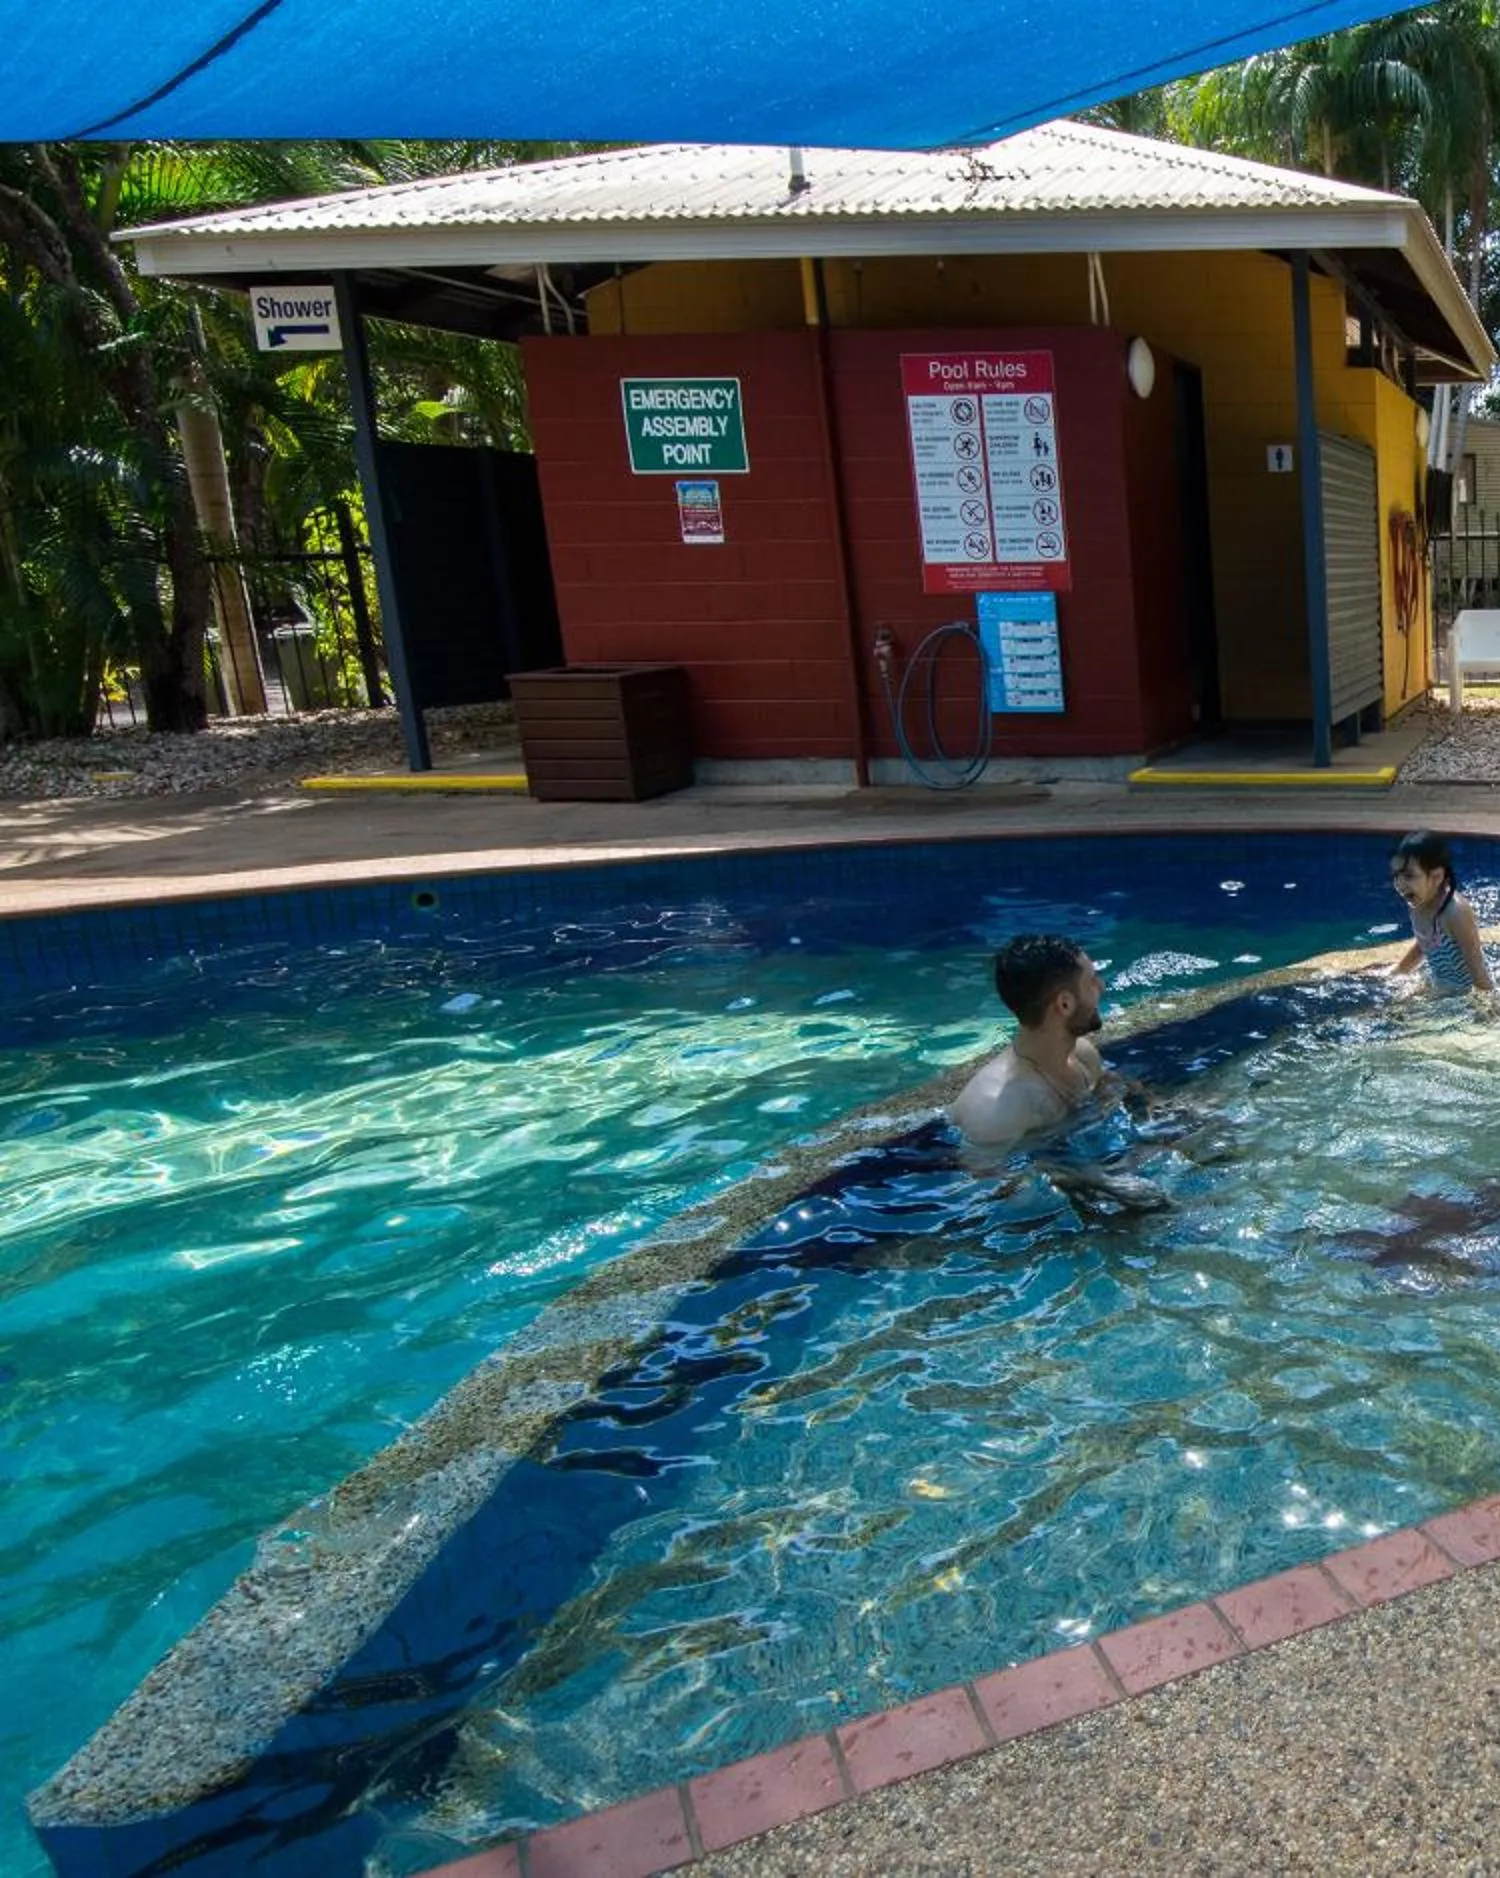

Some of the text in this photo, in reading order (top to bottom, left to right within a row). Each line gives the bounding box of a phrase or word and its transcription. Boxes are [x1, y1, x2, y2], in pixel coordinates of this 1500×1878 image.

[256, 295, 332, 319] Shower
[929, 360, 1027, 379] Pool Rules
[629, 389, 735, 409] EMERGENCY
[641, 416, 729, 437] ASSEMBLY
[662, 444, 712, 465] POINT
